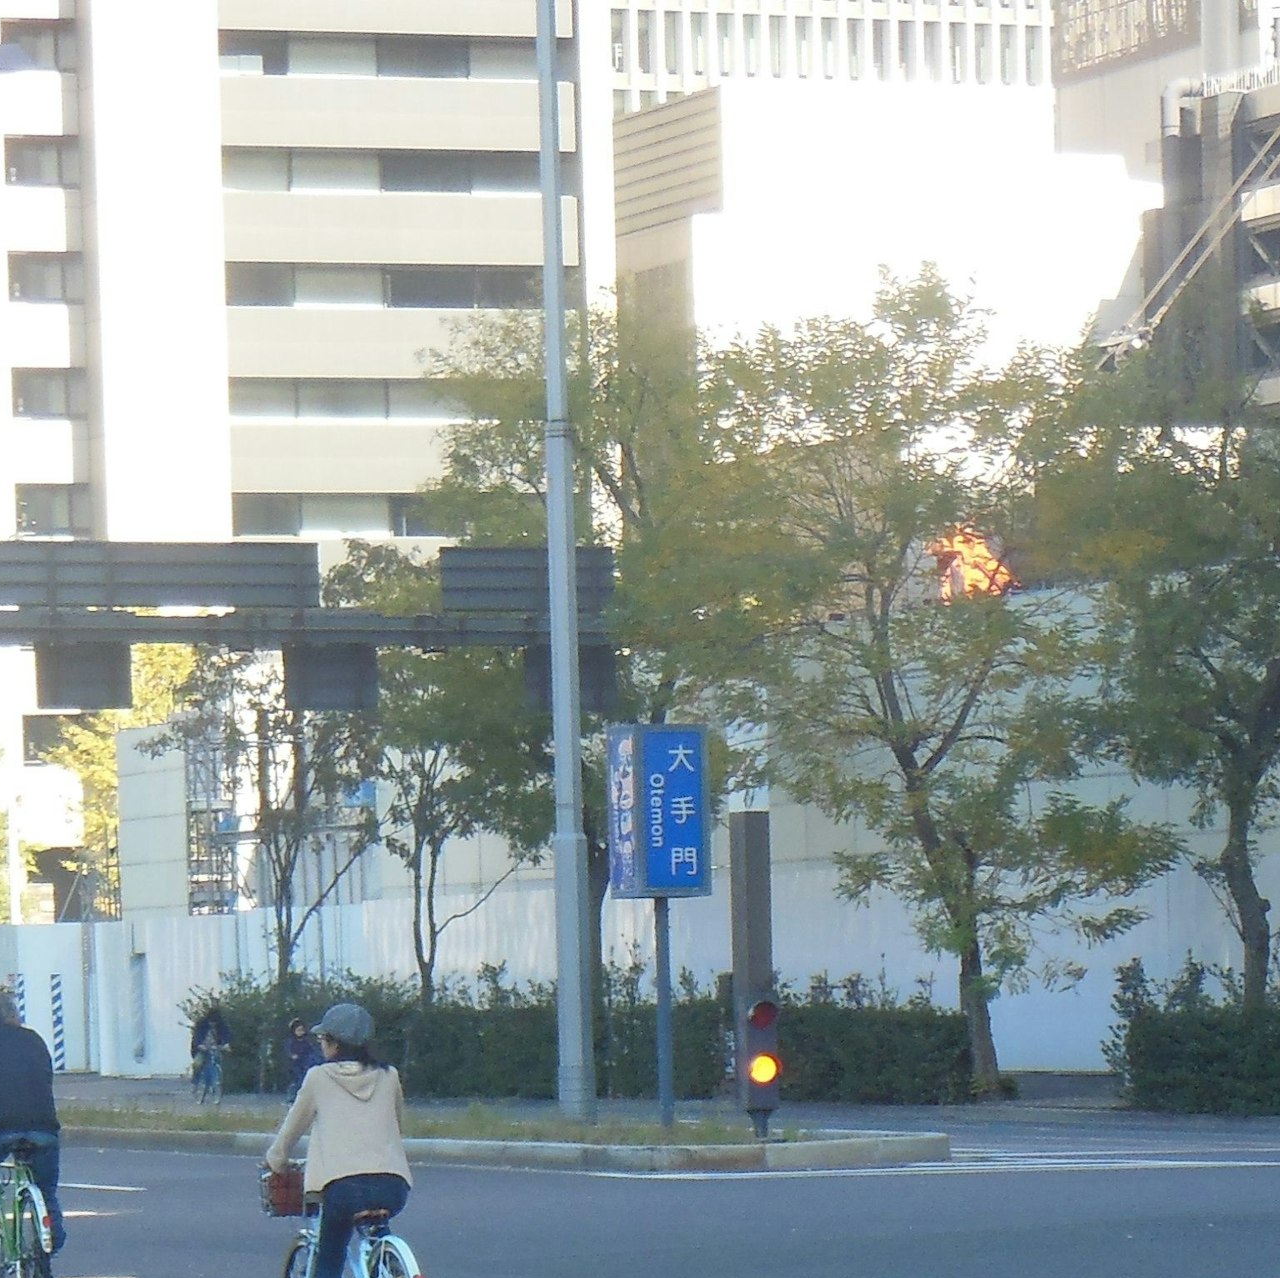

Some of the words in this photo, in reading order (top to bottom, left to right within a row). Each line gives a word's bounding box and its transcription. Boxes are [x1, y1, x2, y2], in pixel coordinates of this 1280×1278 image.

[649, 773, 665, 848] Otemon
[667, 743, 698, 876] 大手門
